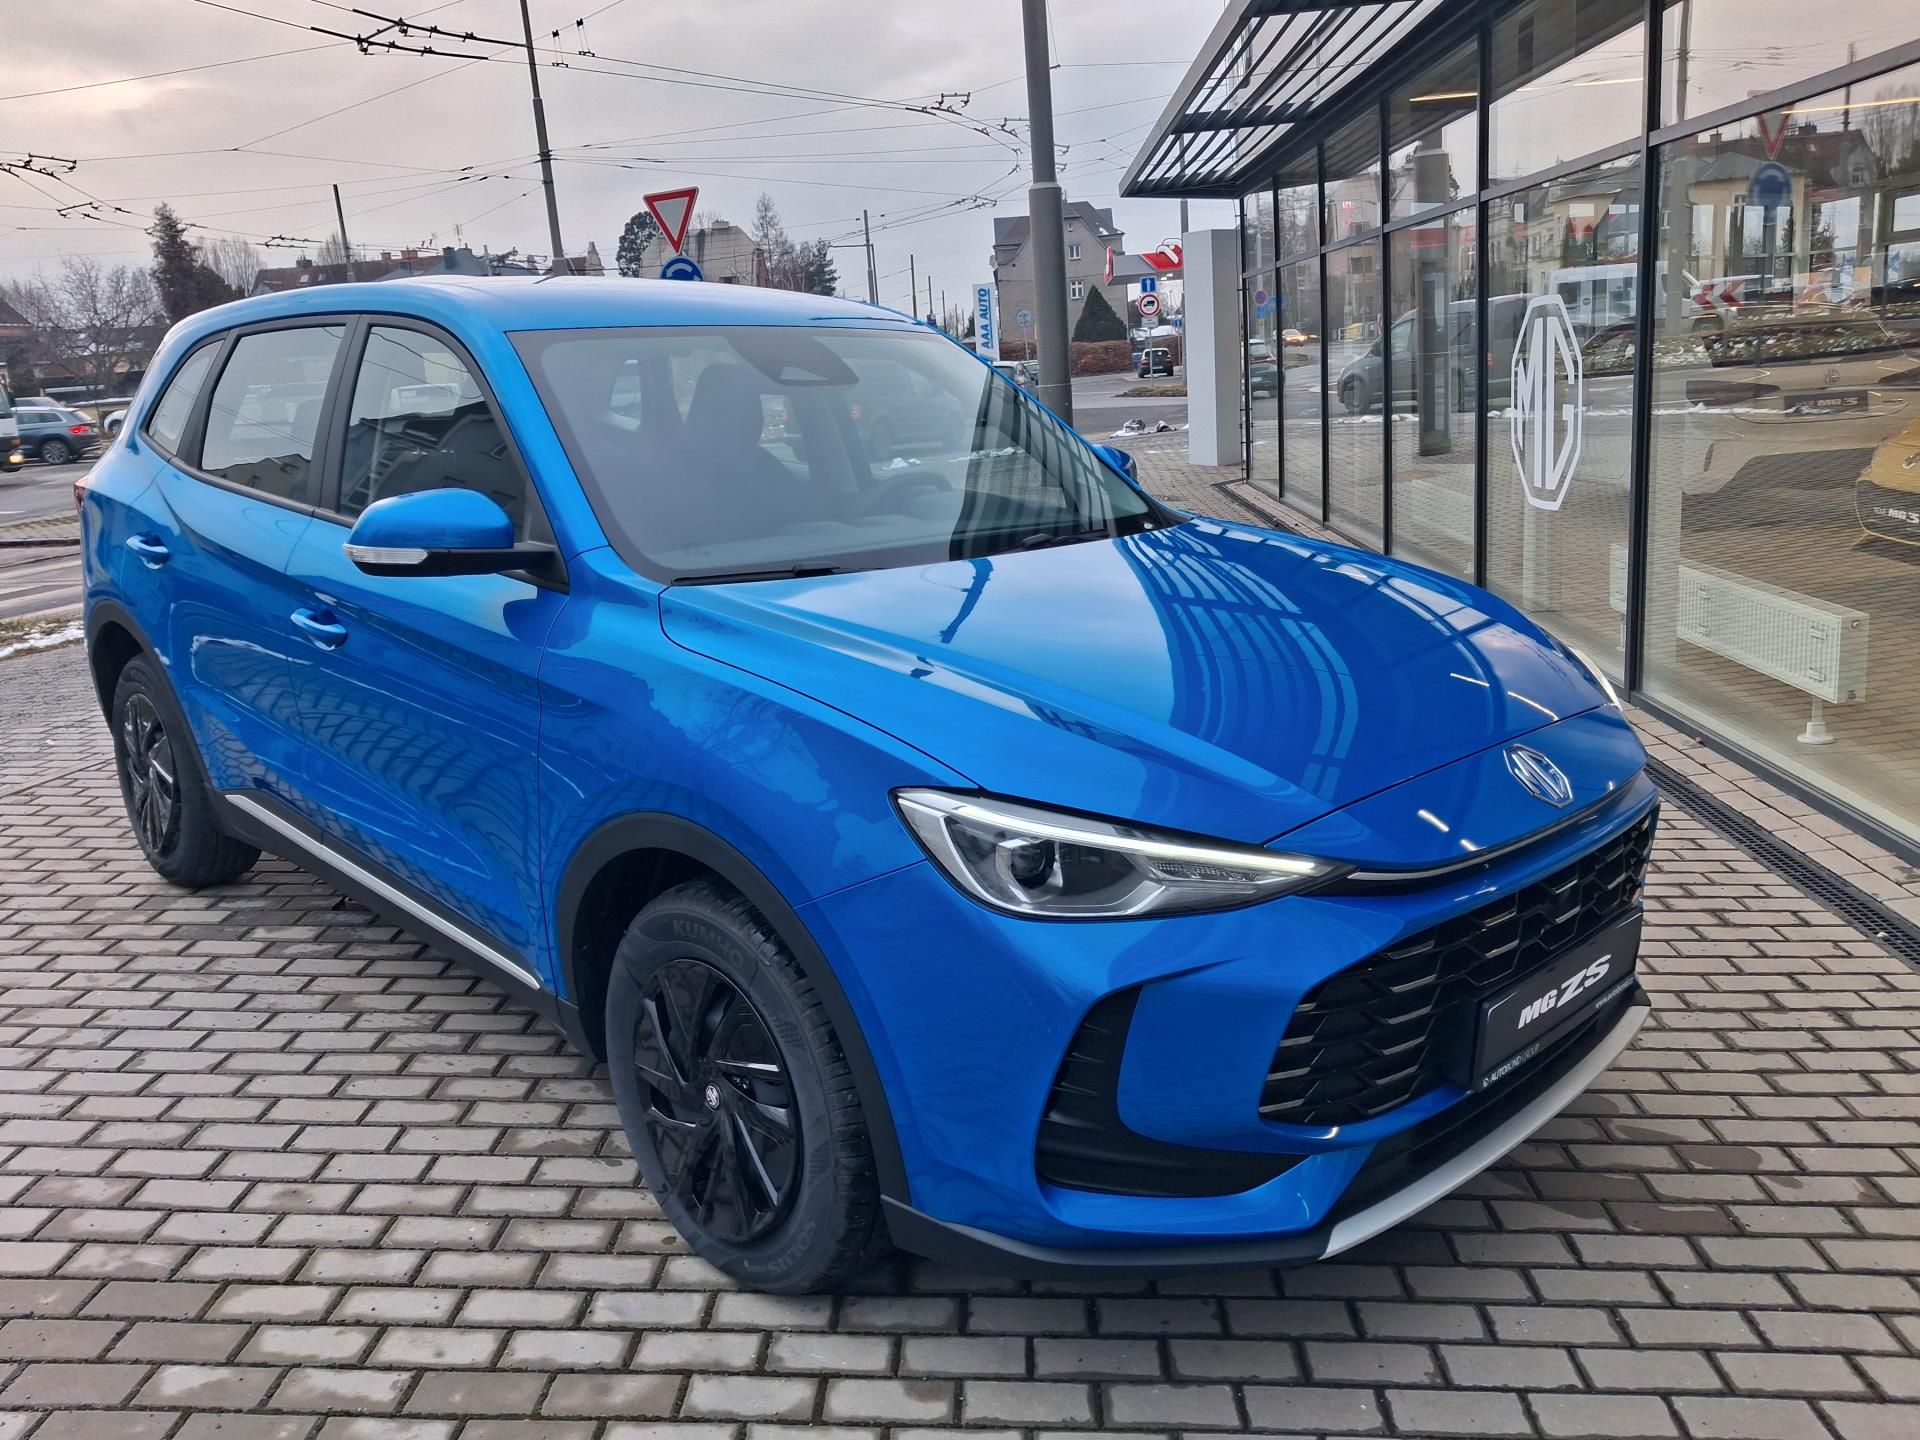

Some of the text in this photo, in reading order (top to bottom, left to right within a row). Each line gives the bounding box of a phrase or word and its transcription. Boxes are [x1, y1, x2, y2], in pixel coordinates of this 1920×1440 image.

[977, 288, 992, 350] AAA AUTO
[1516, 316, 1575, 491] MG
[1510, 750, 1568, 801] MG
[672, 918, 744, 970] KUMHO
[1517, 953, 1612, 1030] MG ZS
